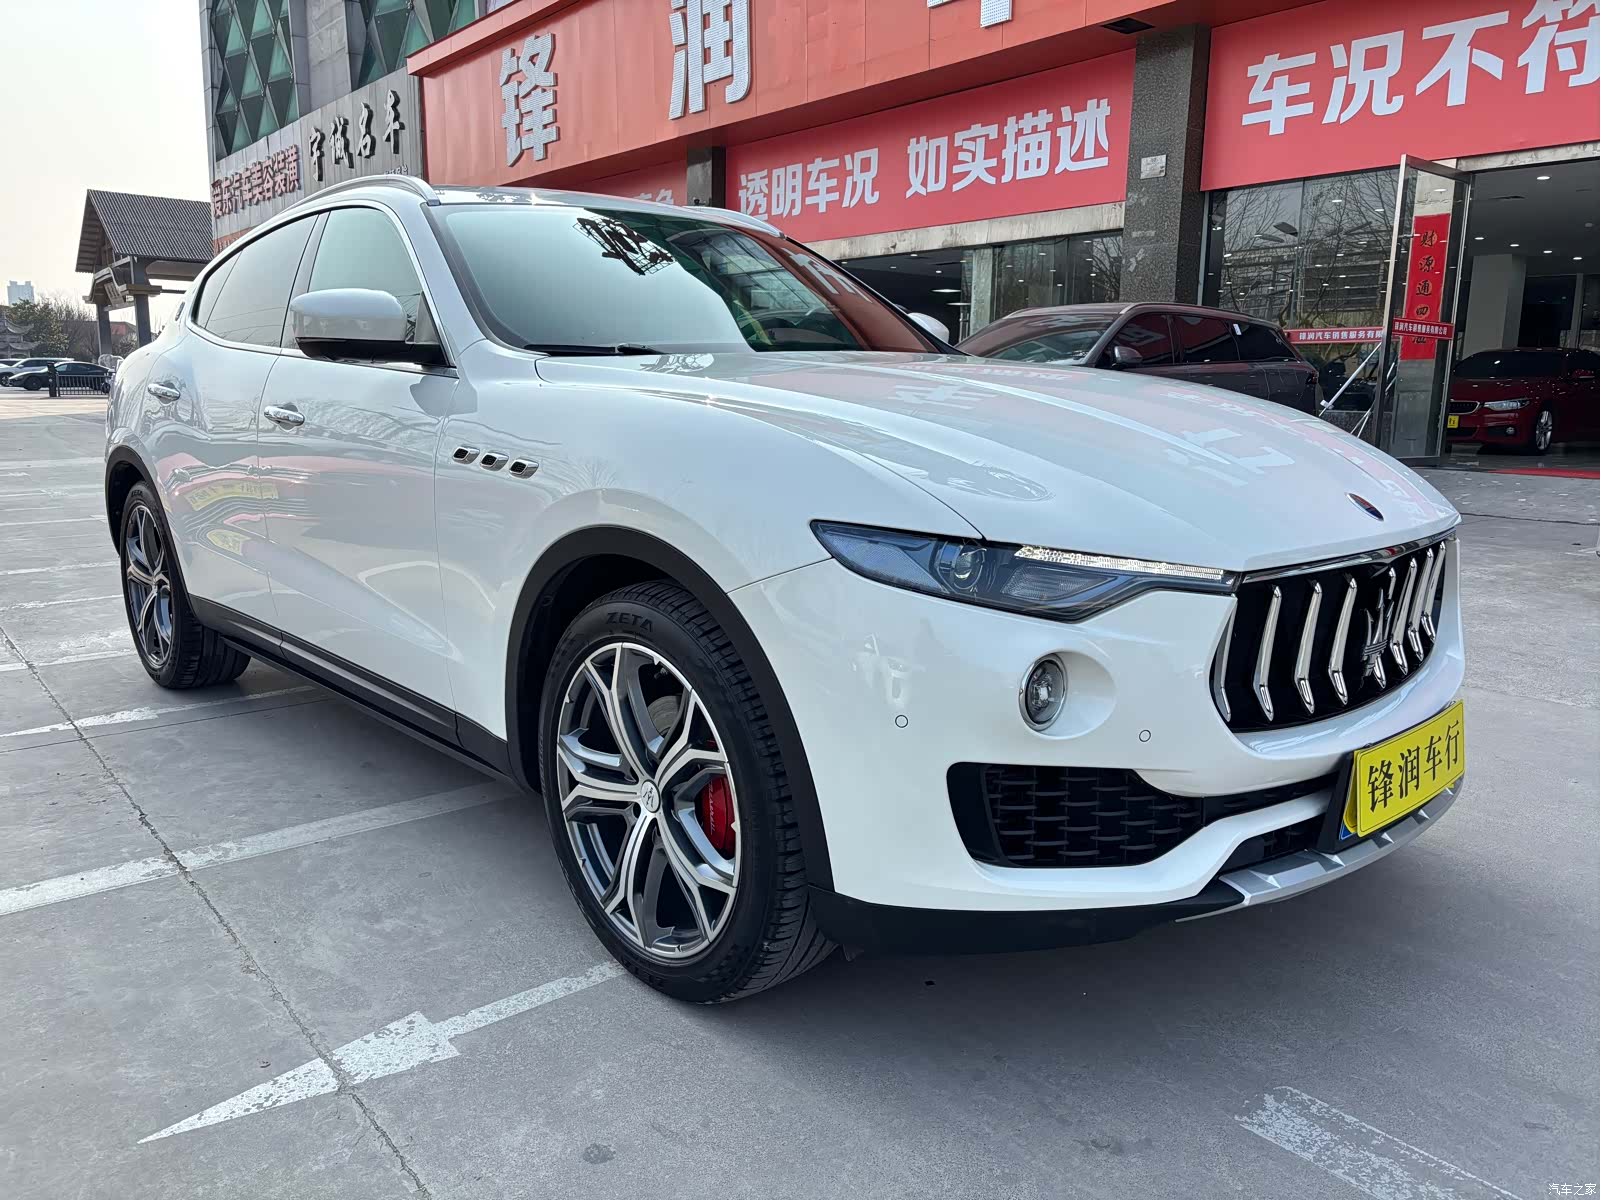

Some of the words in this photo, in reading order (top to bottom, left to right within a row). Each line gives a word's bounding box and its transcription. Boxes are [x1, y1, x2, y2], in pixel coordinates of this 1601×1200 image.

[499, 32, 560, 167] 锋
[668, 0, 754, 120] 润
[1241, 0, 1600, 136] 车况不符
[737, 147, 879, 221] 透明车况
[905, 98, 1111, 199] 如实描述
[606, 611, 653, 632] ZETA
[1367, 719, 1460, 813] 锋润车行
